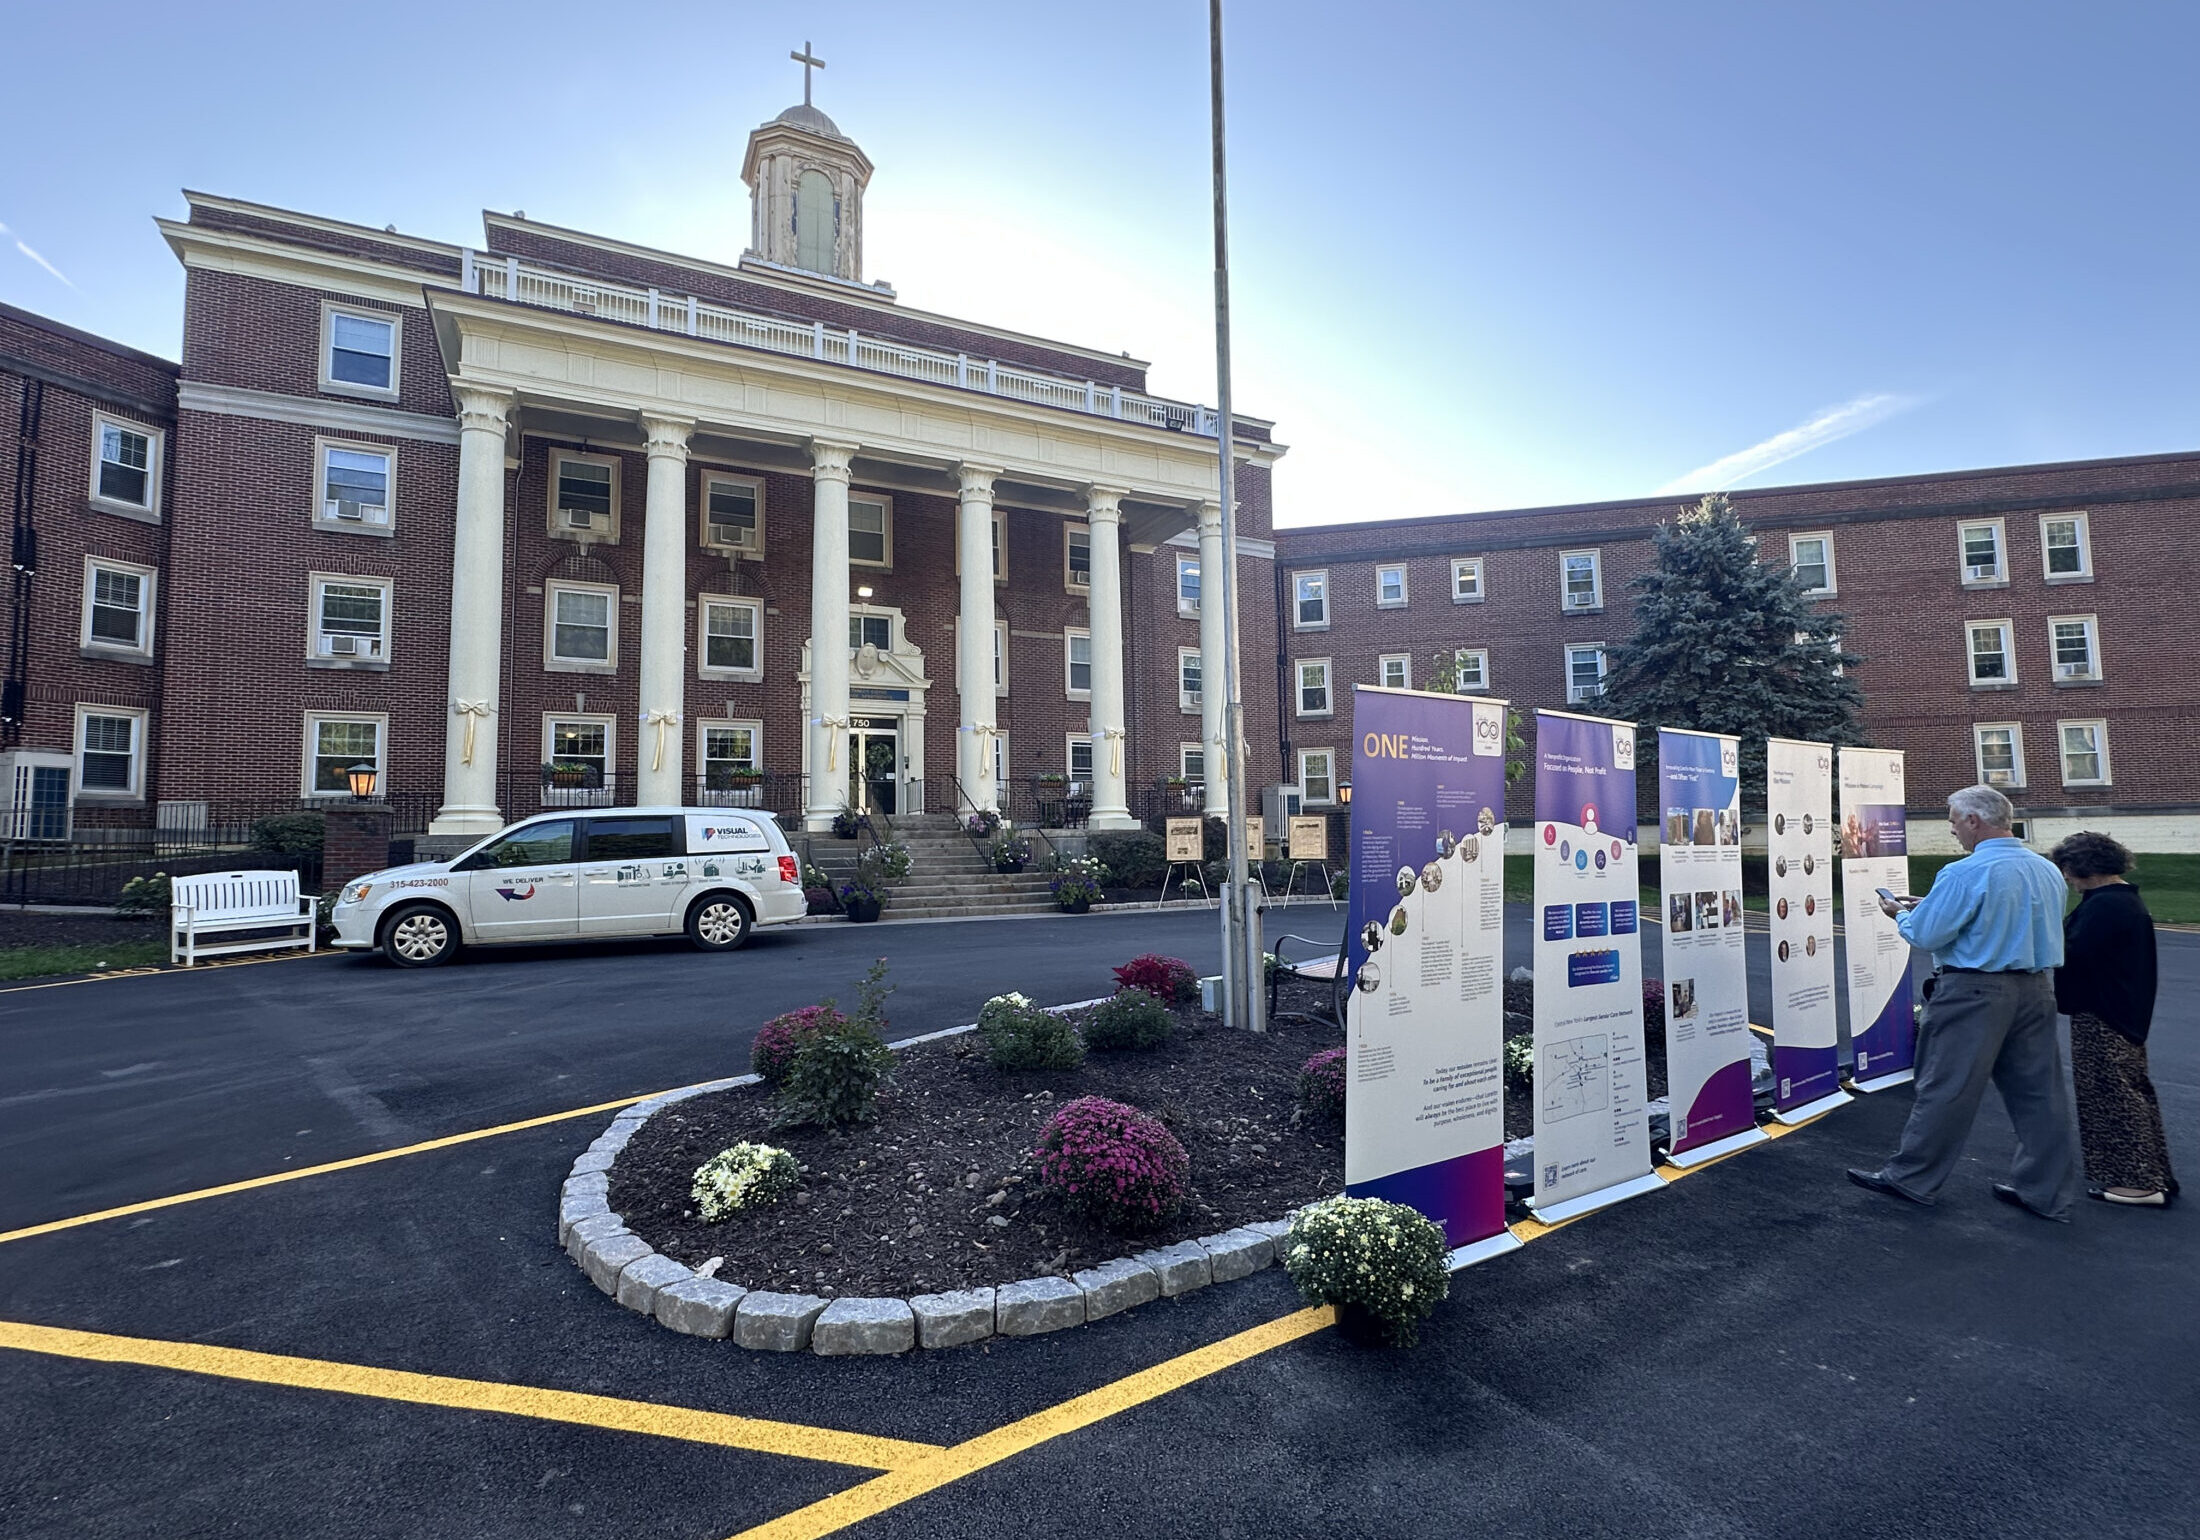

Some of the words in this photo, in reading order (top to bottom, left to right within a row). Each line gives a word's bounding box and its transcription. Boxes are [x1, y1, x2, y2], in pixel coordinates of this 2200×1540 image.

[853, 719, 870, 727] 750
[1363, 732, 1409, 759] ONE
[1543, 762, 1562, 772] Focused
[1584, 766, 1594, 774] Not
[717, 827, 748, 835] VISUAL
[390, 878, 449, 889] 315-423-2000
[1460, 1069, 1484, 1079] exceptional
[1424, 1112, 1441, 1120] always
[1561, 1170, 1575, 1179] network
